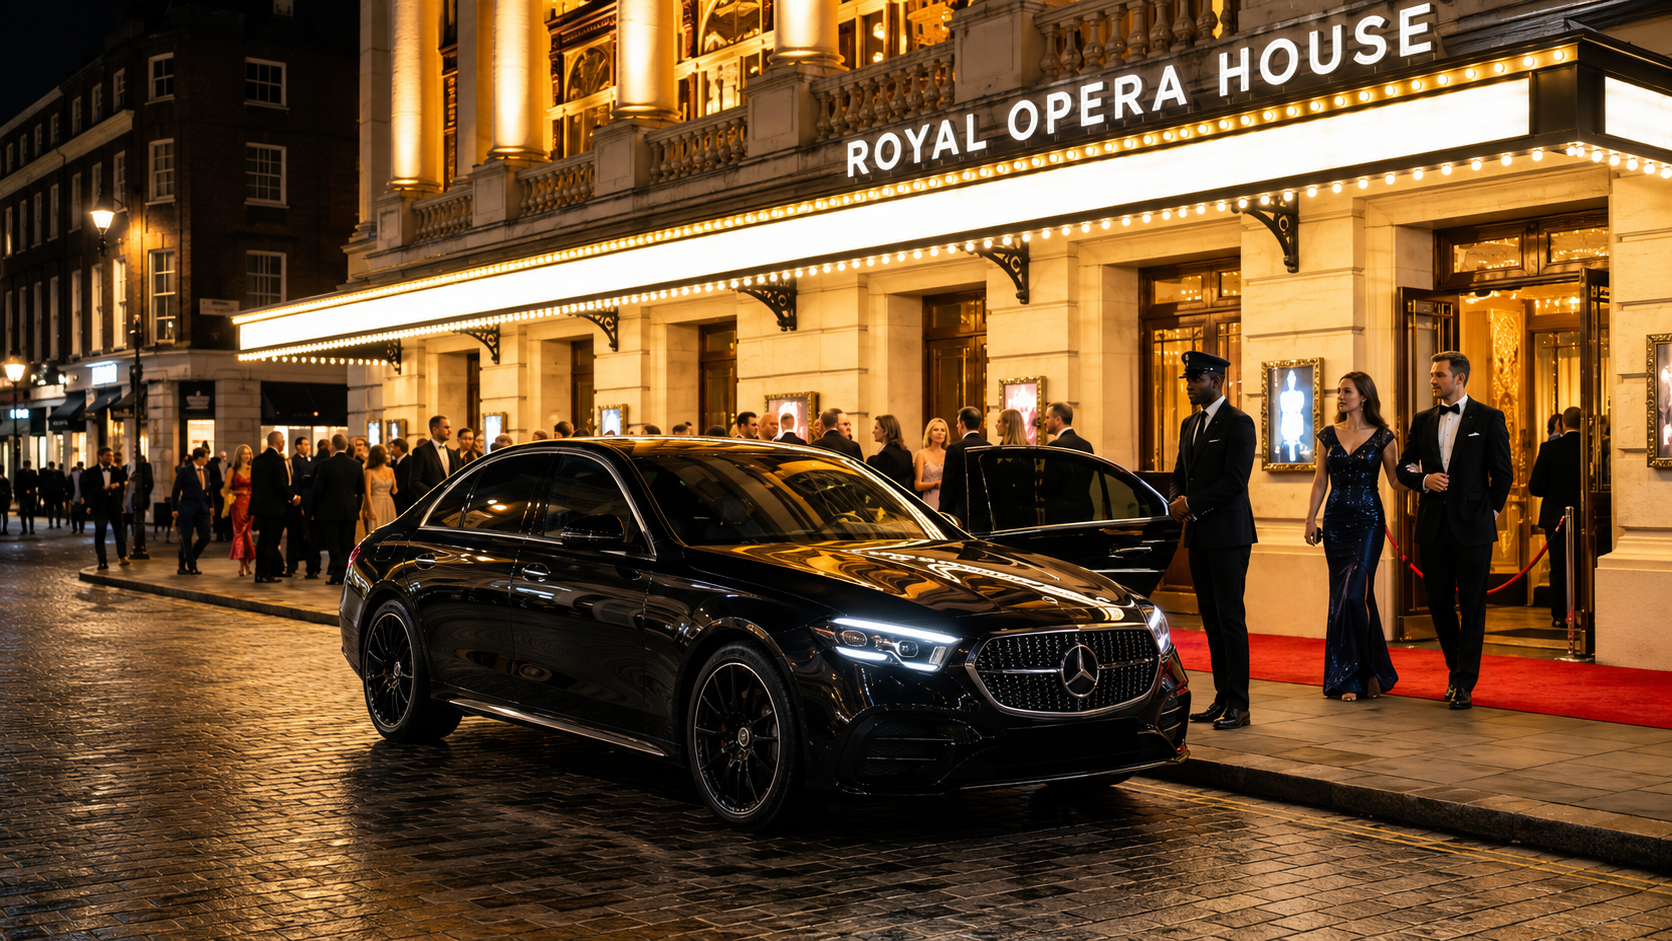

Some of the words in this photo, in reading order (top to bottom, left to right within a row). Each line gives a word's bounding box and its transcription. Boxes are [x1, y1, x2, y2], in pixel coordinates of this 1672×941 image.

[847, 113, 987, 178] ROYAL
[1007, 64, 1188, 141] OPERA
[1219, 2, 1433, 97] HOUSE
